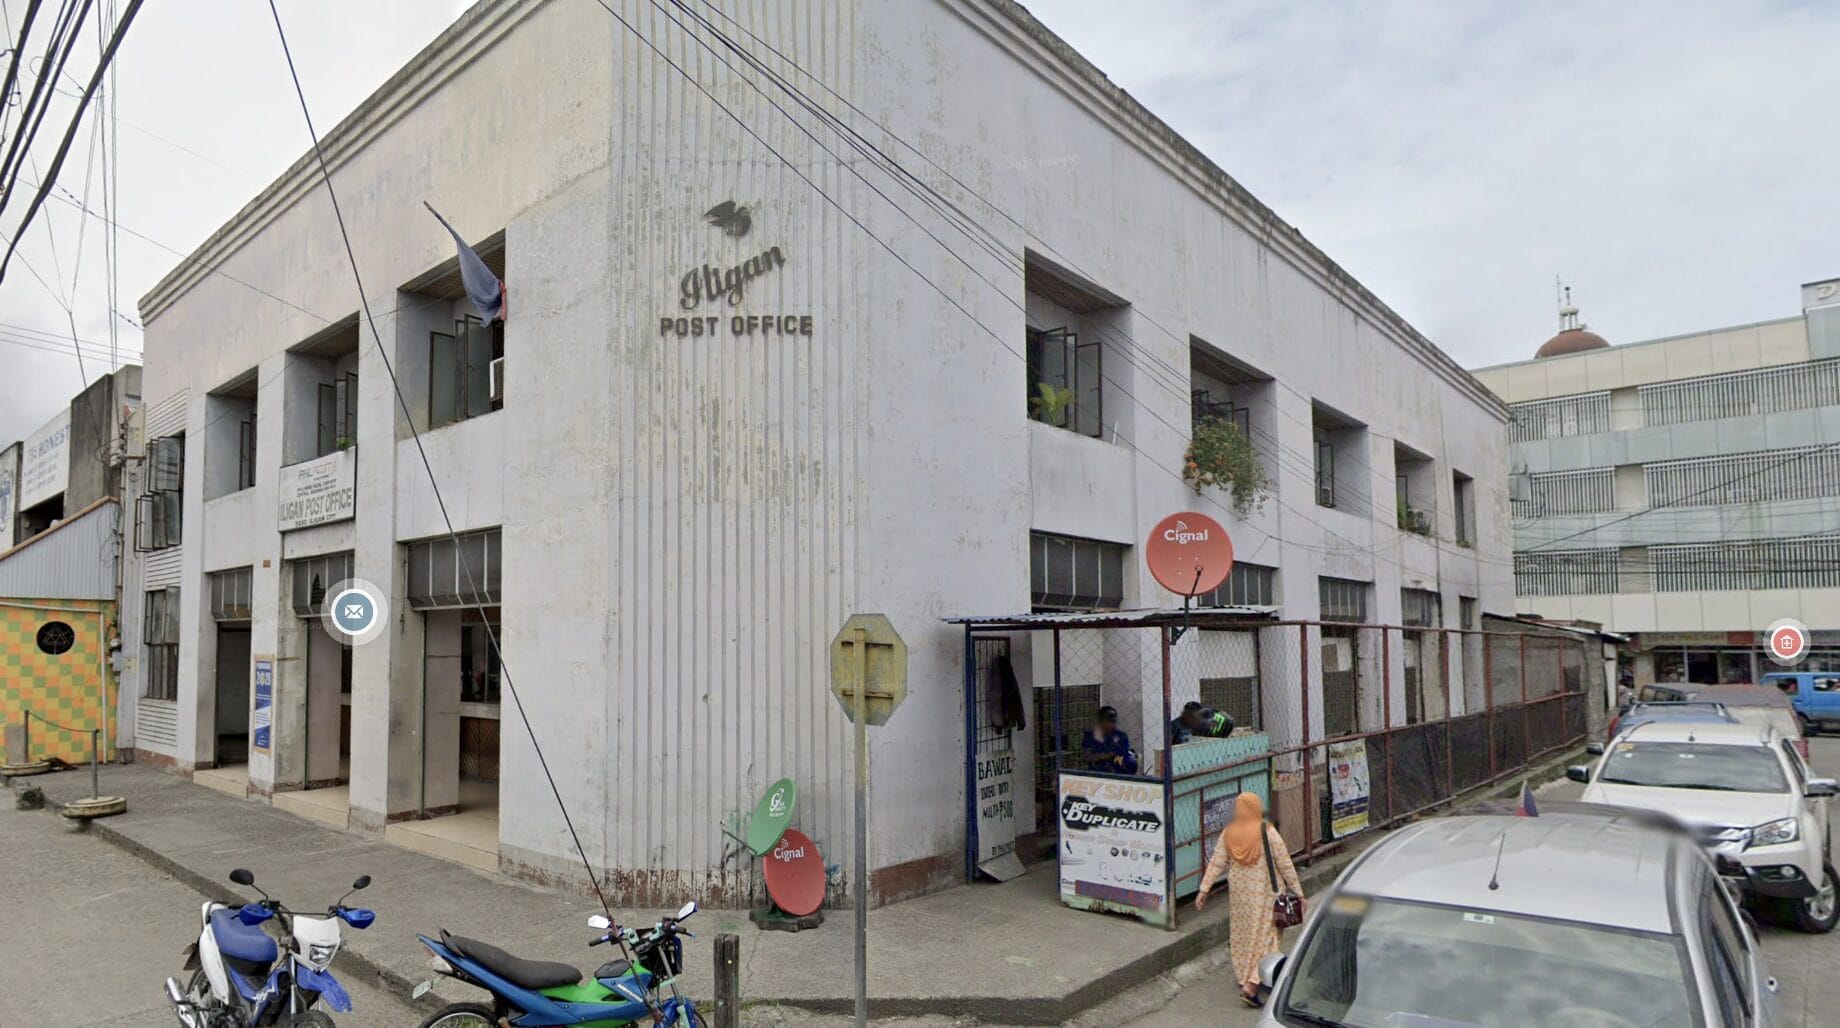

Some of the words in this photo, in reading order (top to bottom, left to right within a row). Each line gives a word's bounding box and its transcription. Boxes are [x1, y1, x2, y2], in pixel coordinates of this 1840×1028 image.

[680, 246, 786, 310] Iligan
[660, 317, 719, 338] POST
[731, 315, 813, 338] OFFICE
[280, 498, 304, 522] ILIGAN
[305, 495, 325, 516] POST
[325, 488, 352, 511] OFFICE
[1164, 529, 1208, 544] Cignal
[977, 756, 1013, 780] BAWAL
[1062, 778, 1104, 798] KEY
[1103, 783, 1163, 805] SHOP
[1072, 801, 1098, 812] KEY
[1066, 807, 1158, 832] DUPLICATE
[773, 846, 805, 862] Cignal
